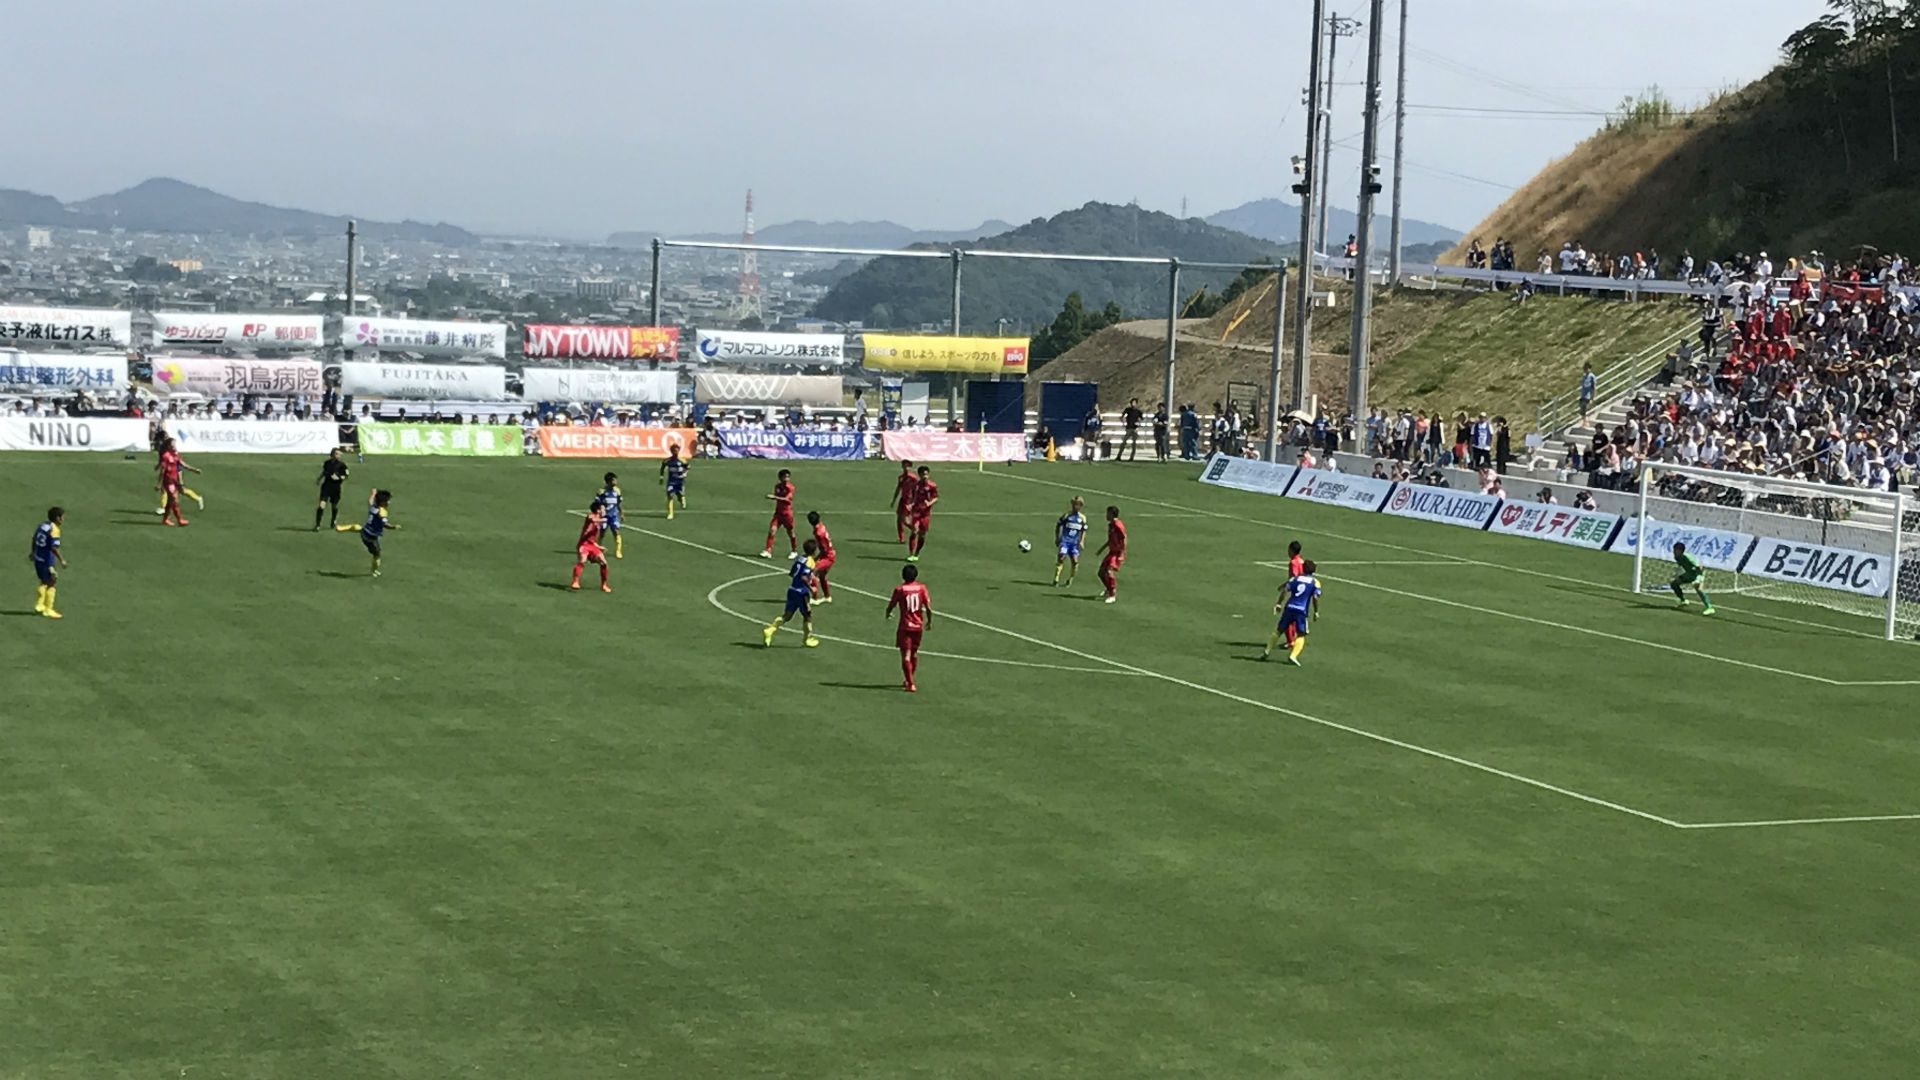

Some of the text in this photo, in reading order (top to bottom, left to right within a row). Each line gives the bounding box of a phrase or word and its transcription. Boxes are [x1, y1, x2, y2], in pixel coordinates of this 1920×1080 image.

[381, 367, 469, 382] FUJITAKA
[28, 422, 92, 446] NINO
[550, 432, 661, 449] MERRELL
[726, 432, 856, 449] MIZUHO みずほ銀行
[1405, 491, 1493, 522] MURAHIDE
[1763, 543, 1879, 589] BEMAC
[1295, 582, 1306, 597] 9
[906, 593, 920, 614] 10
